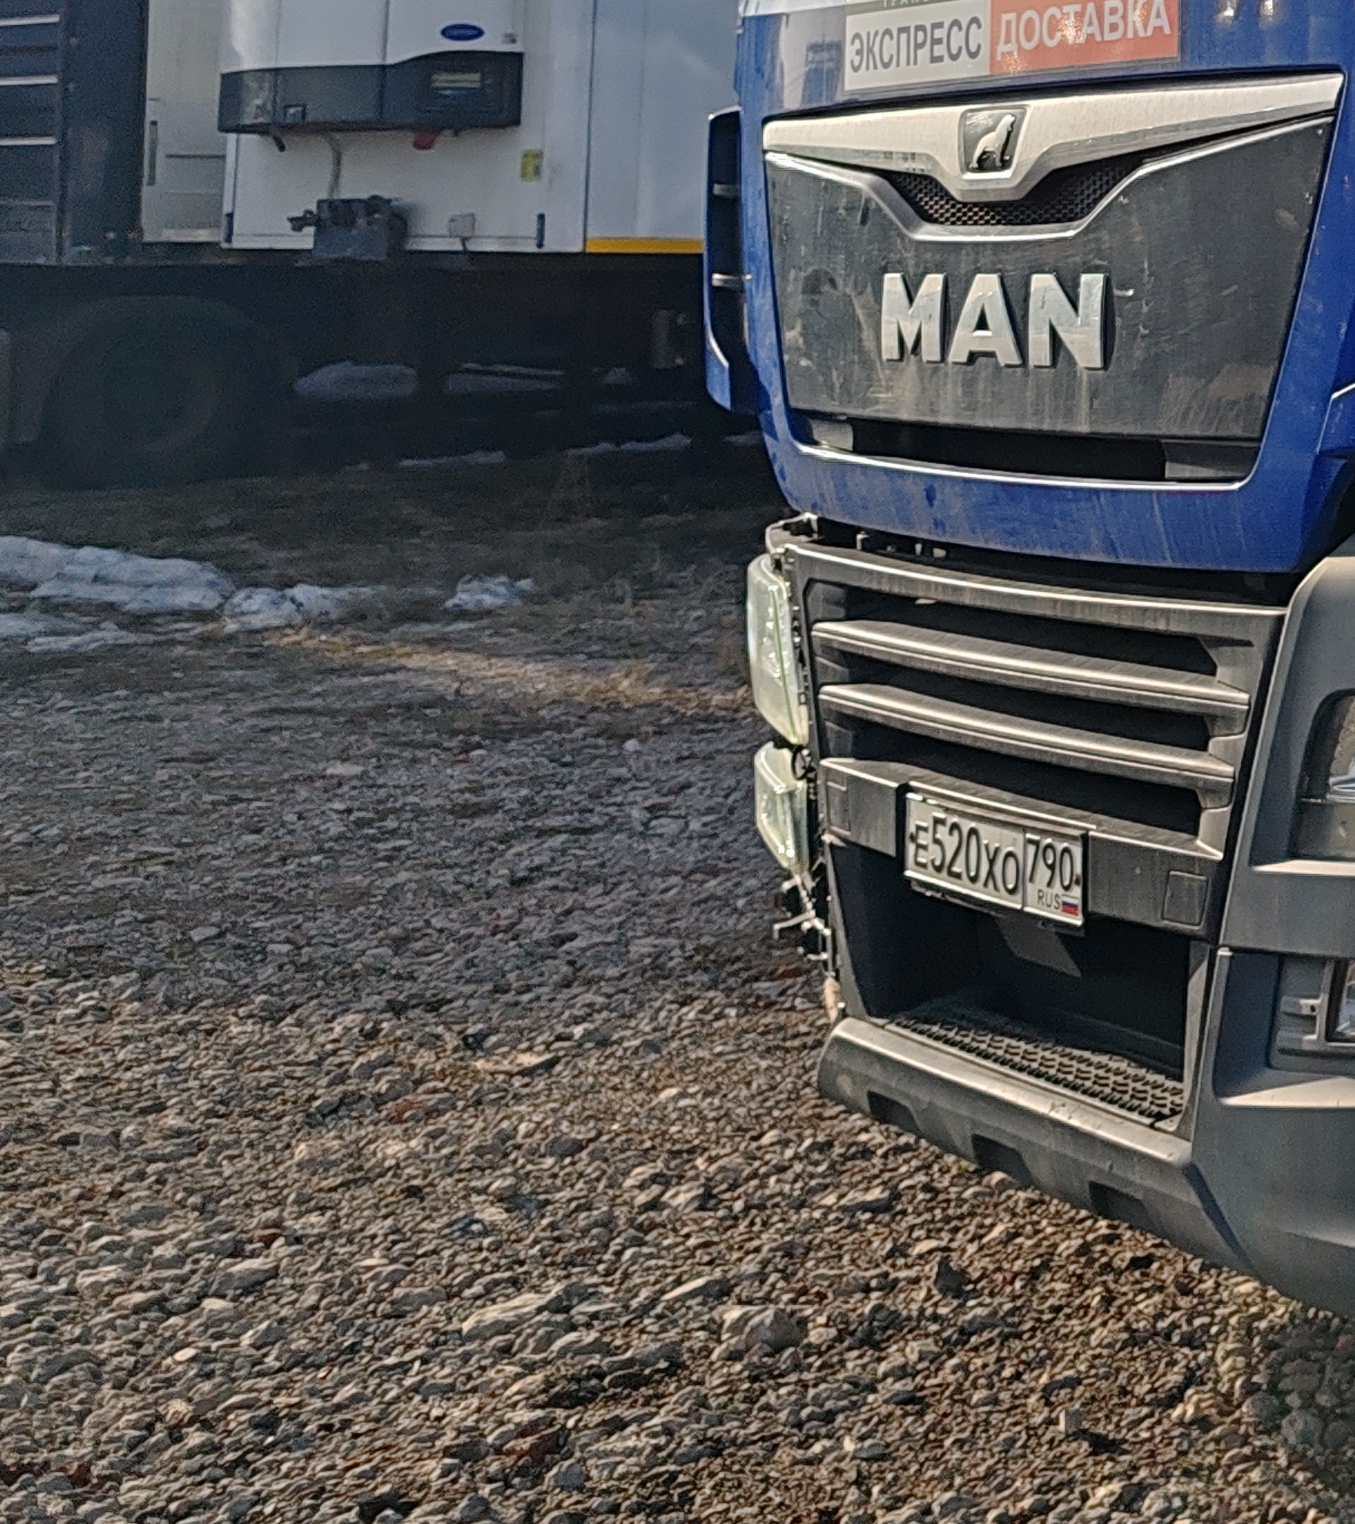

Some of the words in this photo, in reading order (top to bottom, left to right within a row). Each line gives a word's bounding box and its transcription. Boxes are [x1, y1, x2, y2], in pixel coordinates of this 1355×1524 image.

[850, 16, 983, 74] ЭКСПРЕСС
[881, 272, 1106, 369] MAN
[1036, 889, 1061, 910] RUS
